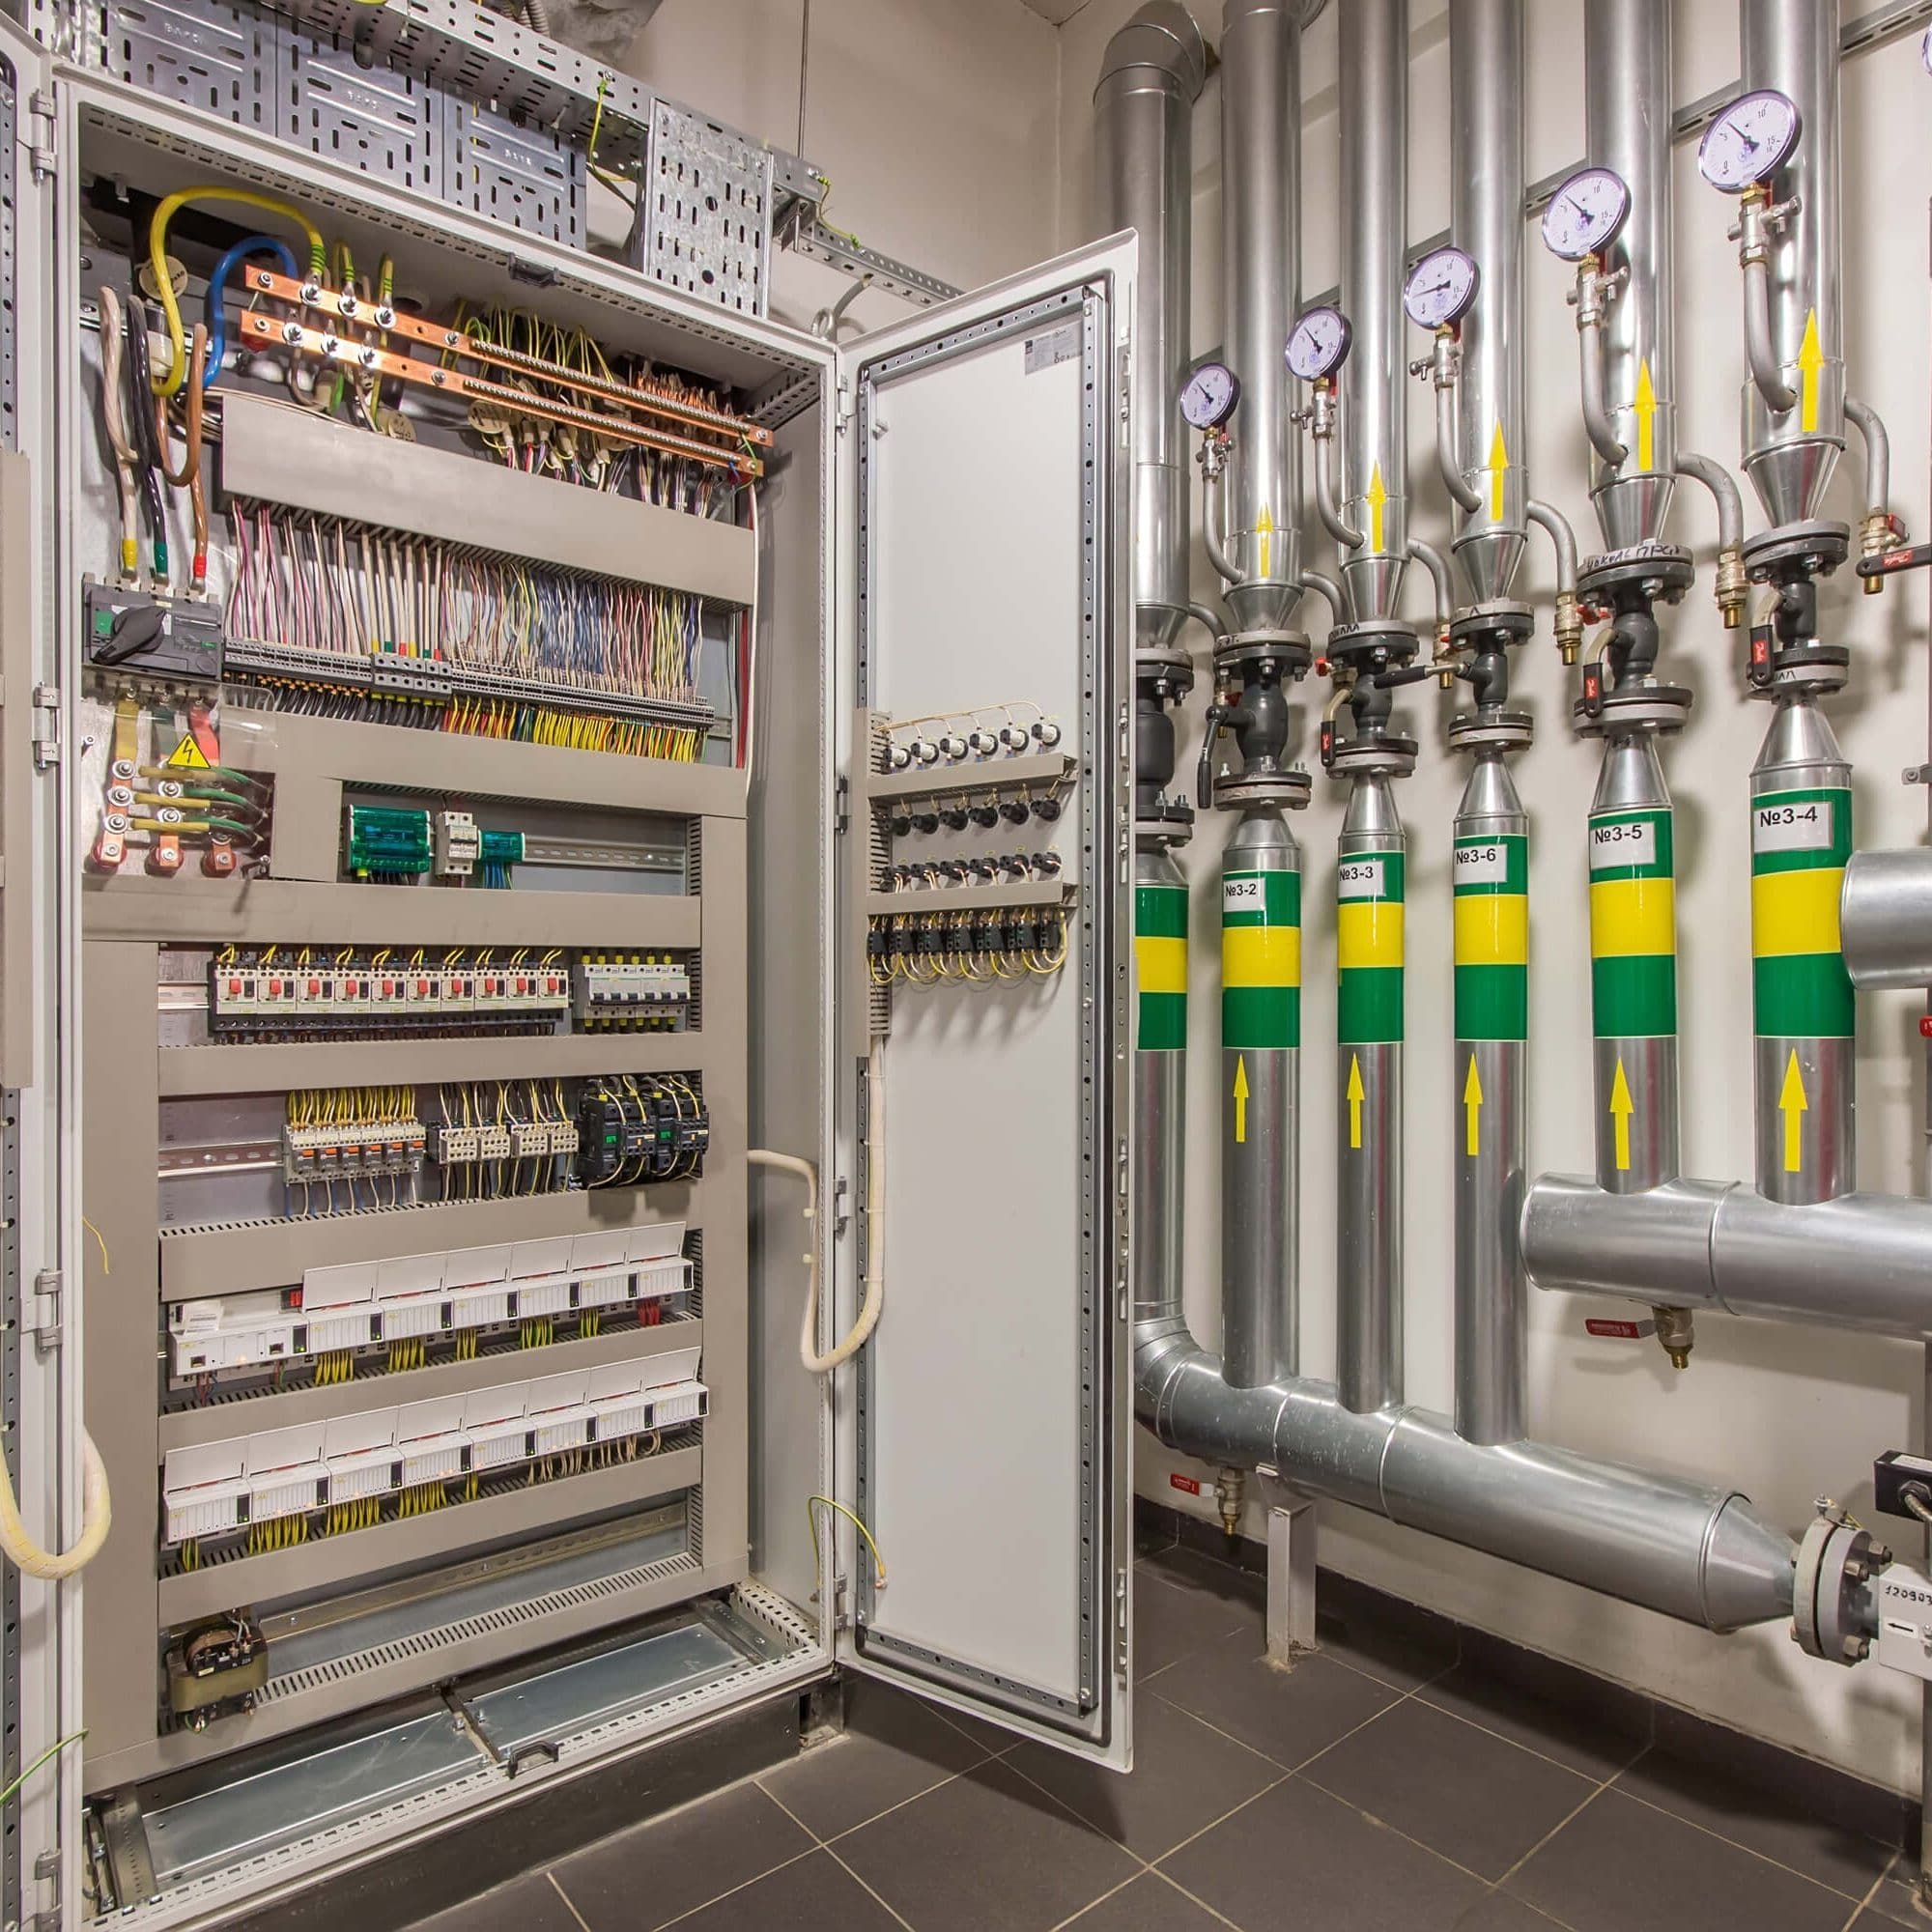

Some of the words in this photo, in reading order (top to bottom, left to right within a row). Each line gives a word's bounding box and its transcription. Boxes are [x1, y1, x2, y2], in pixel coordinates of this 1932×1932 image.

[1757, 109, 1767, 119] 10
[1767, 136, 1776, 146] 15
[1760, 806, 1818, 828] №3-4
[1595, 824, 1643, 845] №3-5
[1456, 847, 1496, 865] №3-6
[1339, 866, 1375, 881] №3-3
[1225, 883, 1257, 897] №3-2
